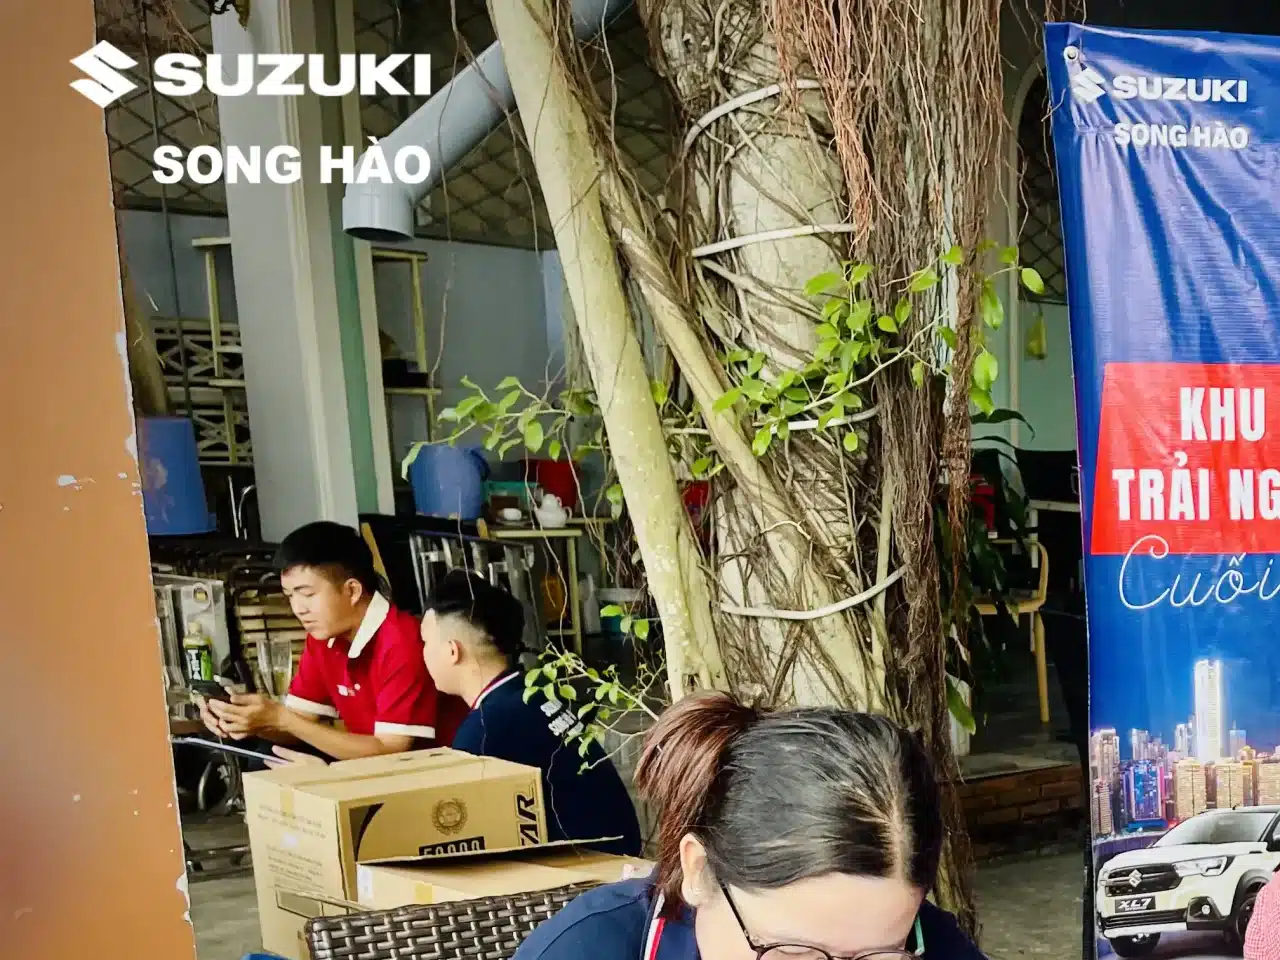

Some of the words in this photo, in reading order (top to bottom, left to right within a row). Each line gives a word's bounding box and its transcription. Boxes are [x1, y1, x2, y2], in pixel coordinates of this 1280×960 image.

[1113, 76, 1248, 103] SUZUKI
[1113, 122, 1187, 148] SONG
[1194, 120, 1248, 149] HÀO
[1180, 387, 1265, 441] KHU
[1113, 450, 1210, 521] TRẢI
[1118, 897, 1152, 909] XL7
